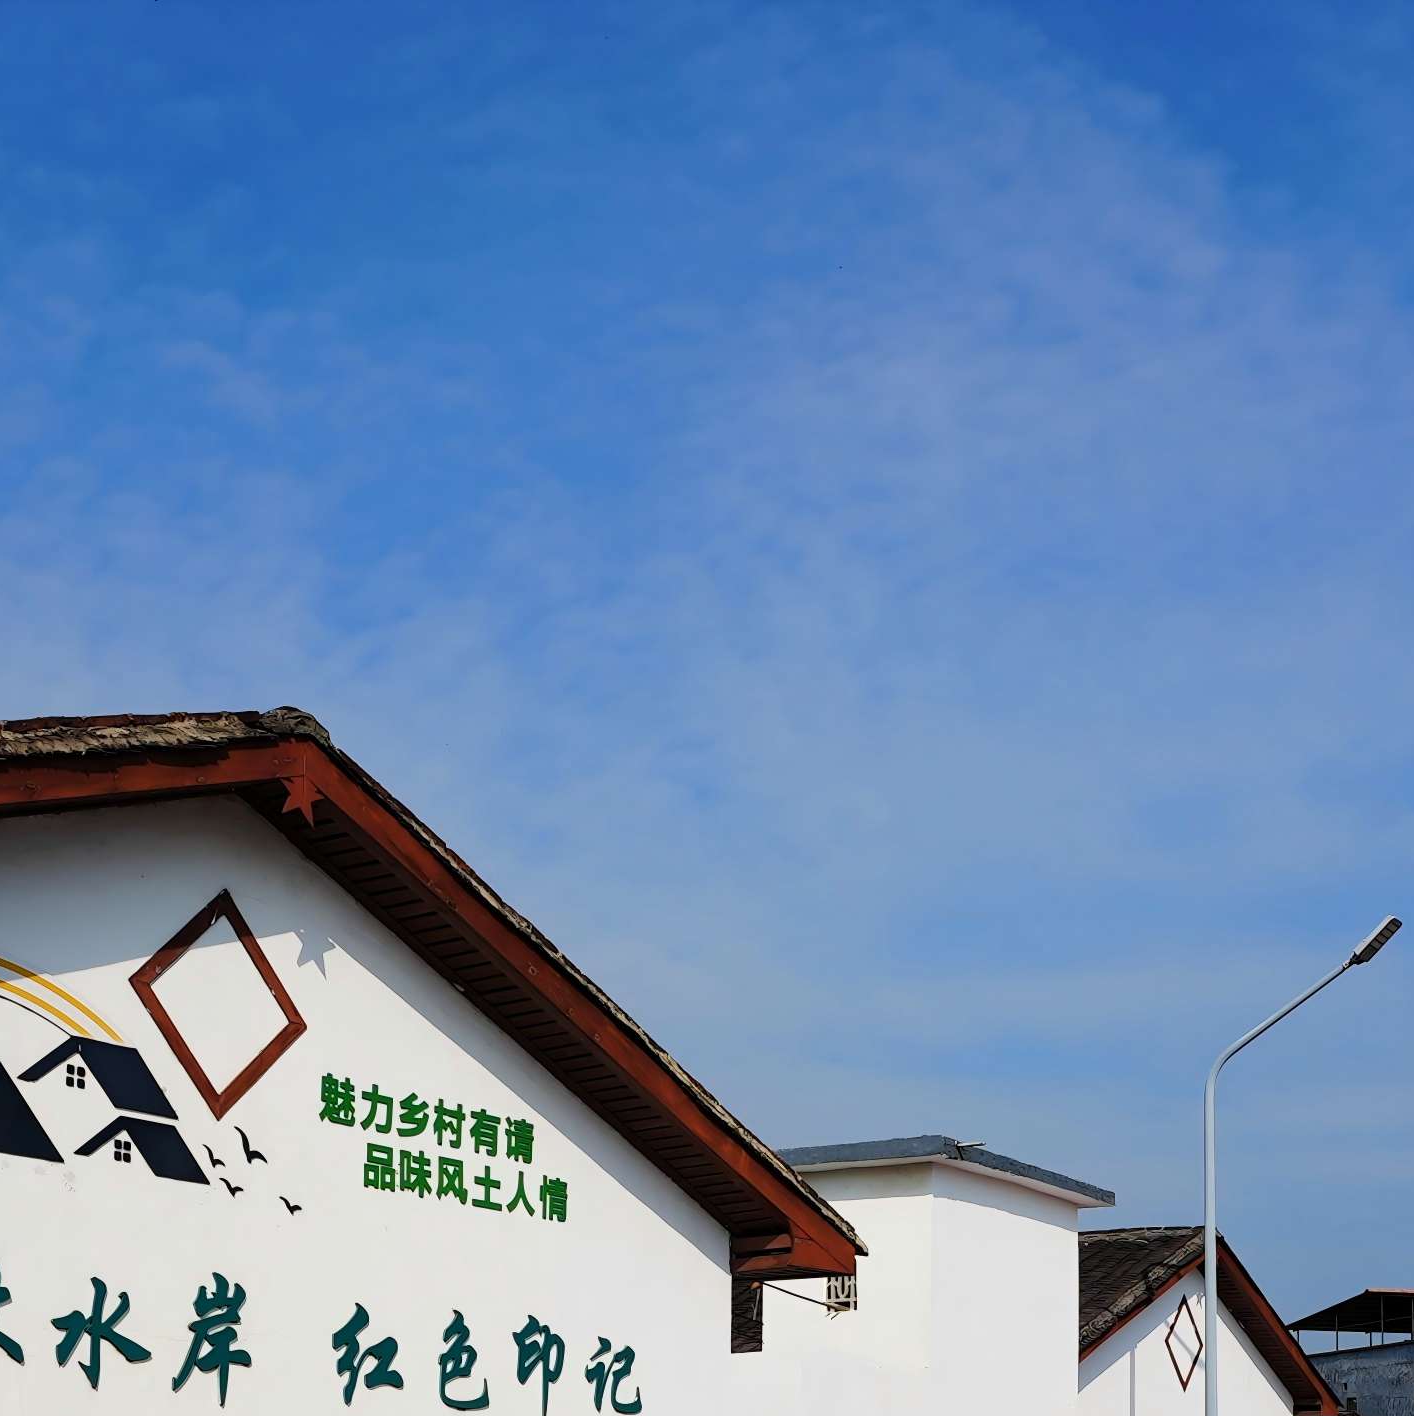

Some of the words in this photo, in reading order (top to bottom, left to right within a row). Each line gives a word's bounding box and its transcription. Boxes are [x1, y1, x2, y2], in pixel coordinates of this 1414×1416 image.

[319, 1073, 534, 1164] 魅力乡村有请
[363, 1143, 568, 1222] 品味风土人情
